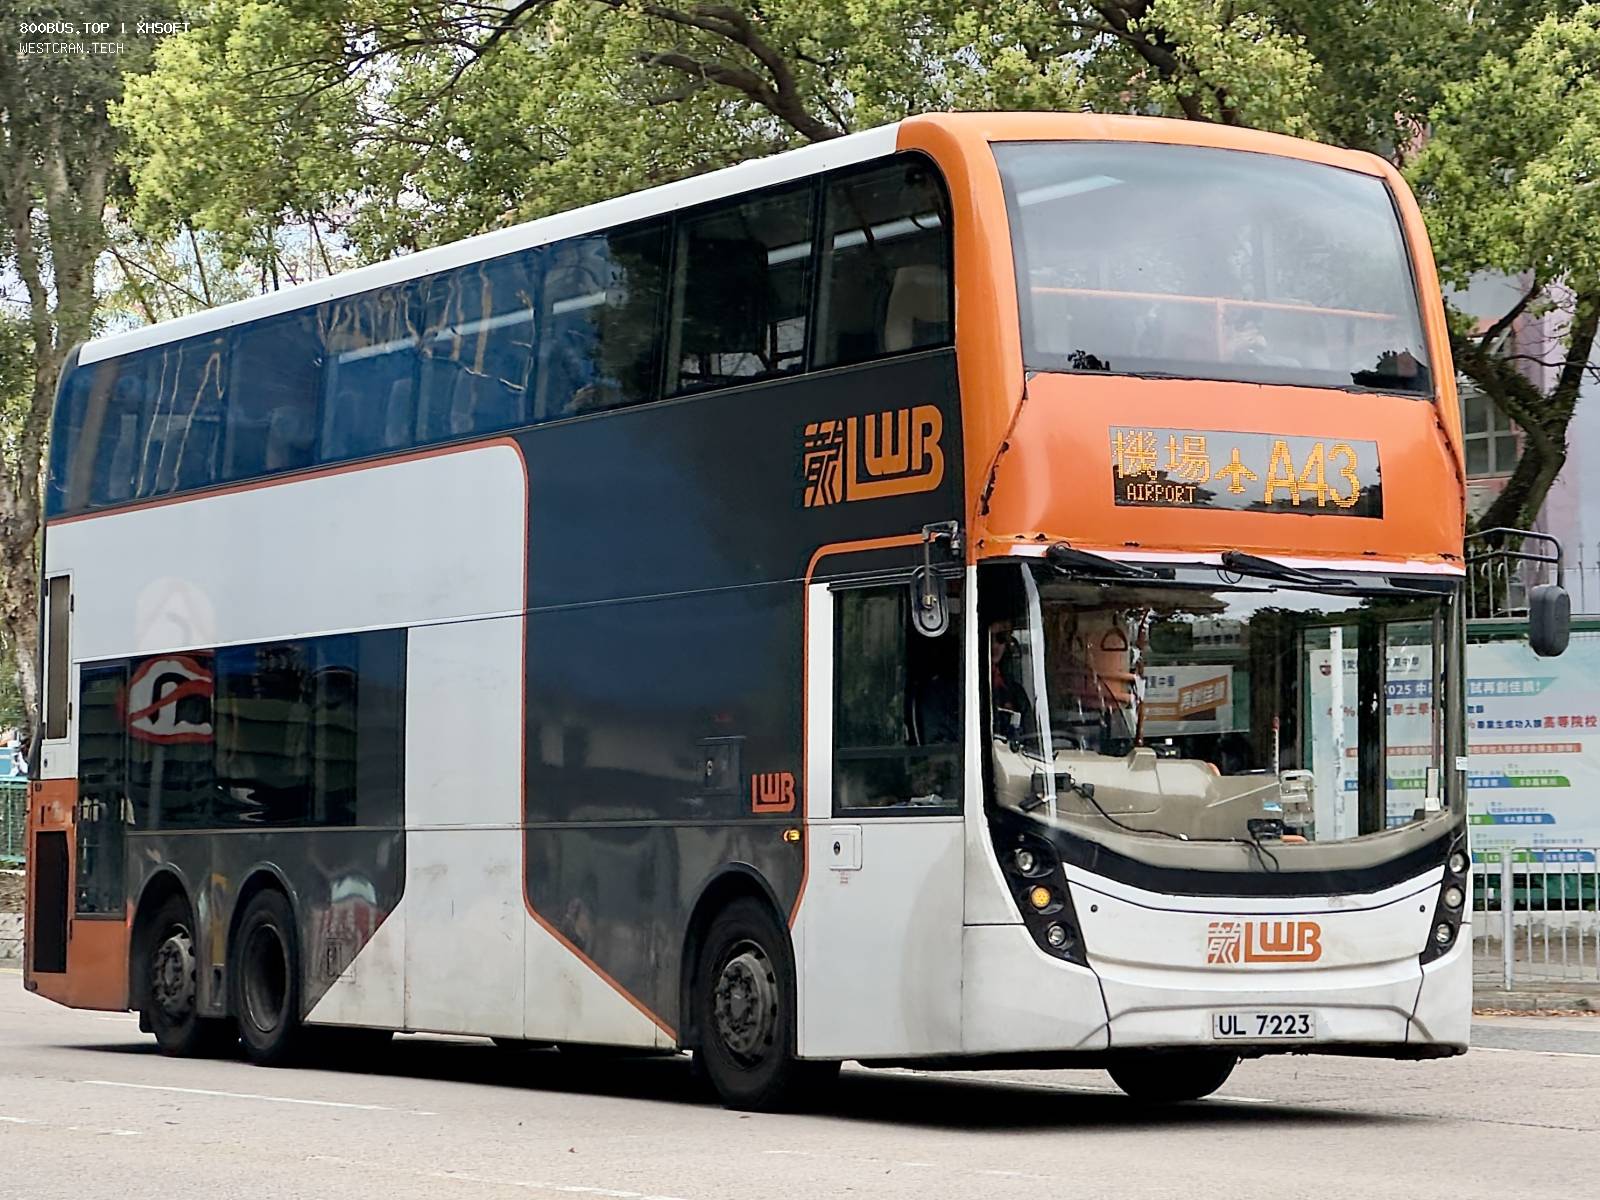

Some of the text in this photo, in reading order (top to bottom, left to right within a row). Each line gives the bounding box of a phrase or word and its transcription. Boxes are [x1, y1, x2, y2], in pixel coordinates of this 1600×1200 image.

[846, 404, 945, 502] LWB
[1111, 430, 1361, 508] 機場 A43
[1126, 482, 1197, 504] AIRPORT
[752, 772, 795, 813] LWB
[1244, 921, 1322, 963] LWB
[1218, 1014, 1310, 1035] UL 7223
